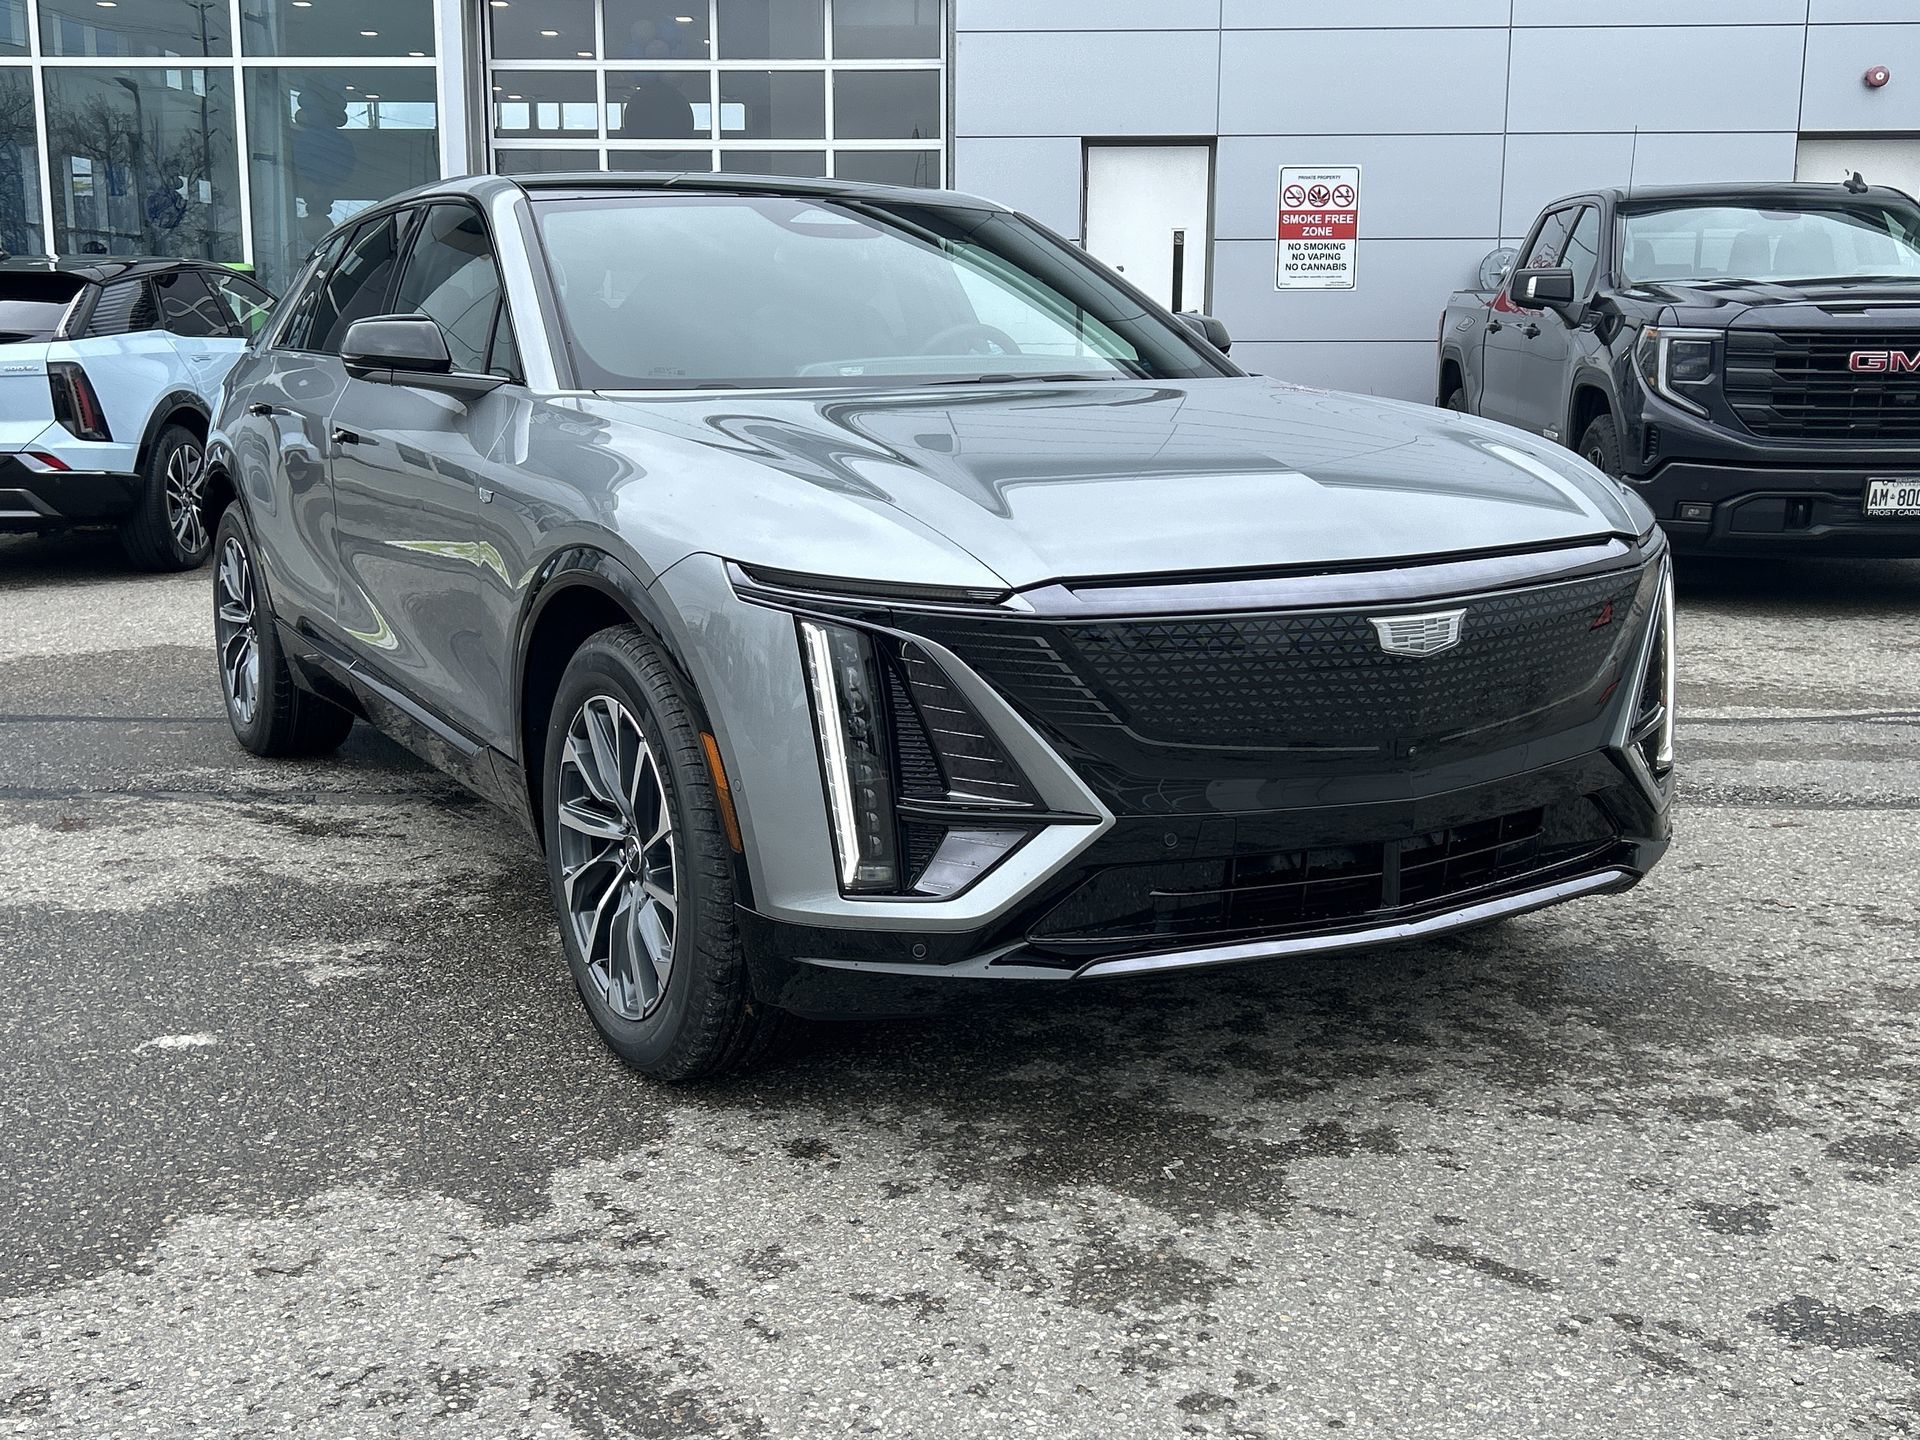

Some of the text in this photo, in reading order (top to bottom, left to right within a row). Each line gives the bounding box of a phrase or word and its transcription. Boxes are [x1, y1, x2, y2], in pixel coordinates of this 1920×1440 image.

[1282, 214, 1354, 224] SMOKE FREE
[1302, 226, 1333, 236] ZONE
[1303, 243, 1346, 251] SMOKING
[1285, 263, 1347, 271] NO CANNABIS
[1849, 351, 1920, 372] GM
